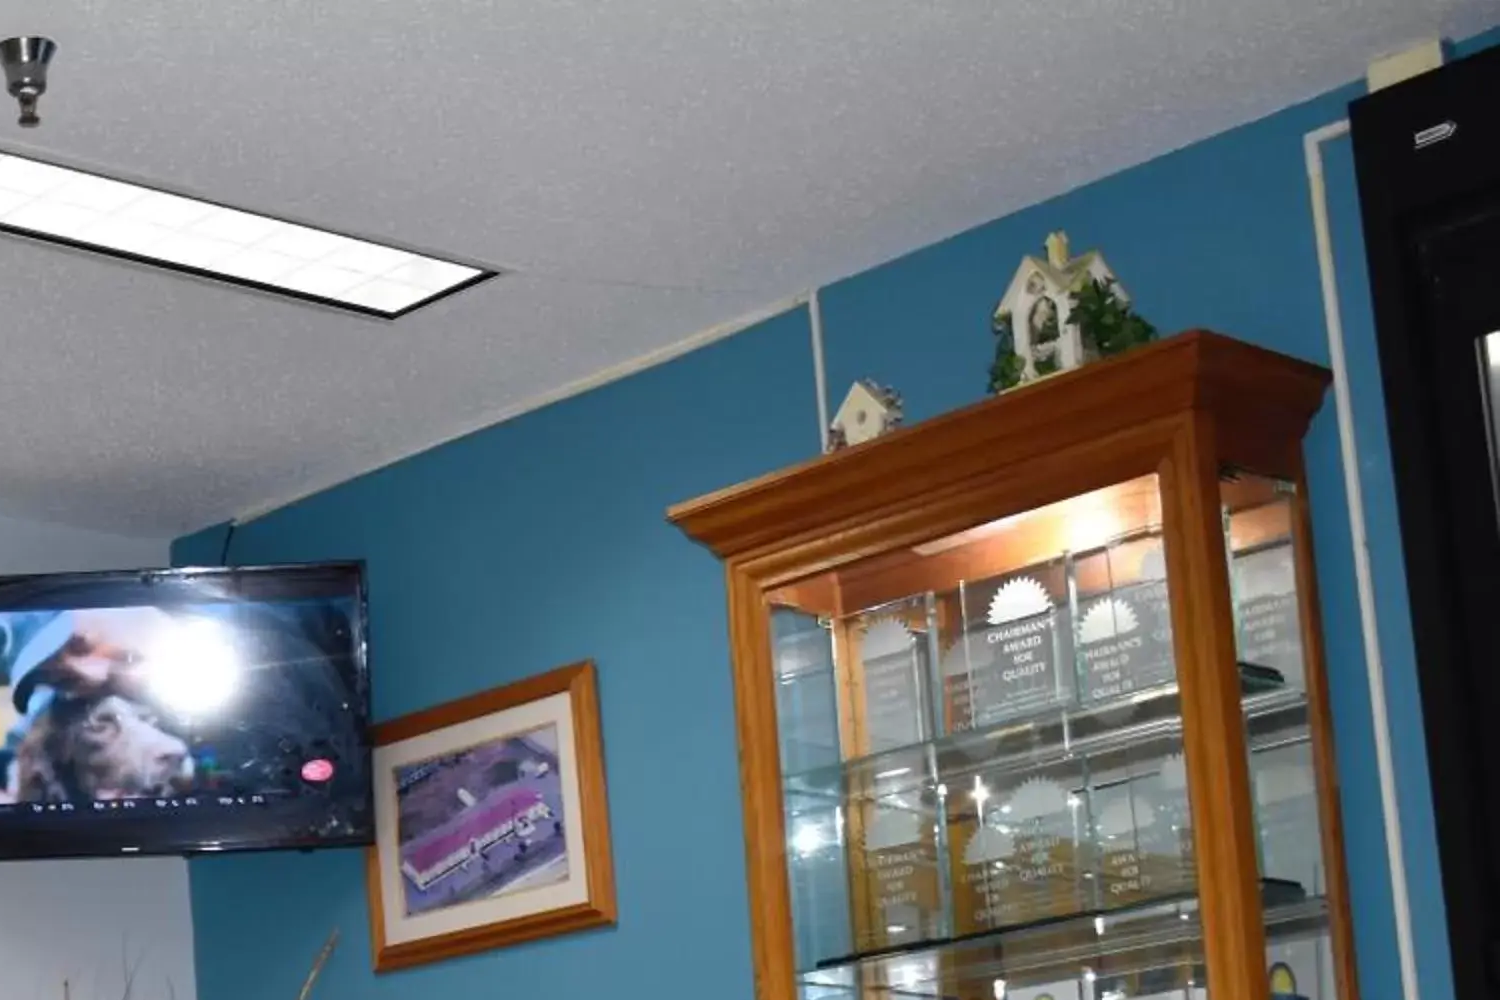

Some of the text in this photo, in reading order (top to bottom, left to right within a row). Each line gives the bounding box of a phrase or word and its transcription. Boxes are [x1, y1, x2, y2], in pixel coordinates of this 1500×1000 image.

[987, 617, 1056, 644] CHAIRMAN'S
[1002, 635, 1042, 653] AWARD
[1002, 661, 1046, 682] QUALITY
